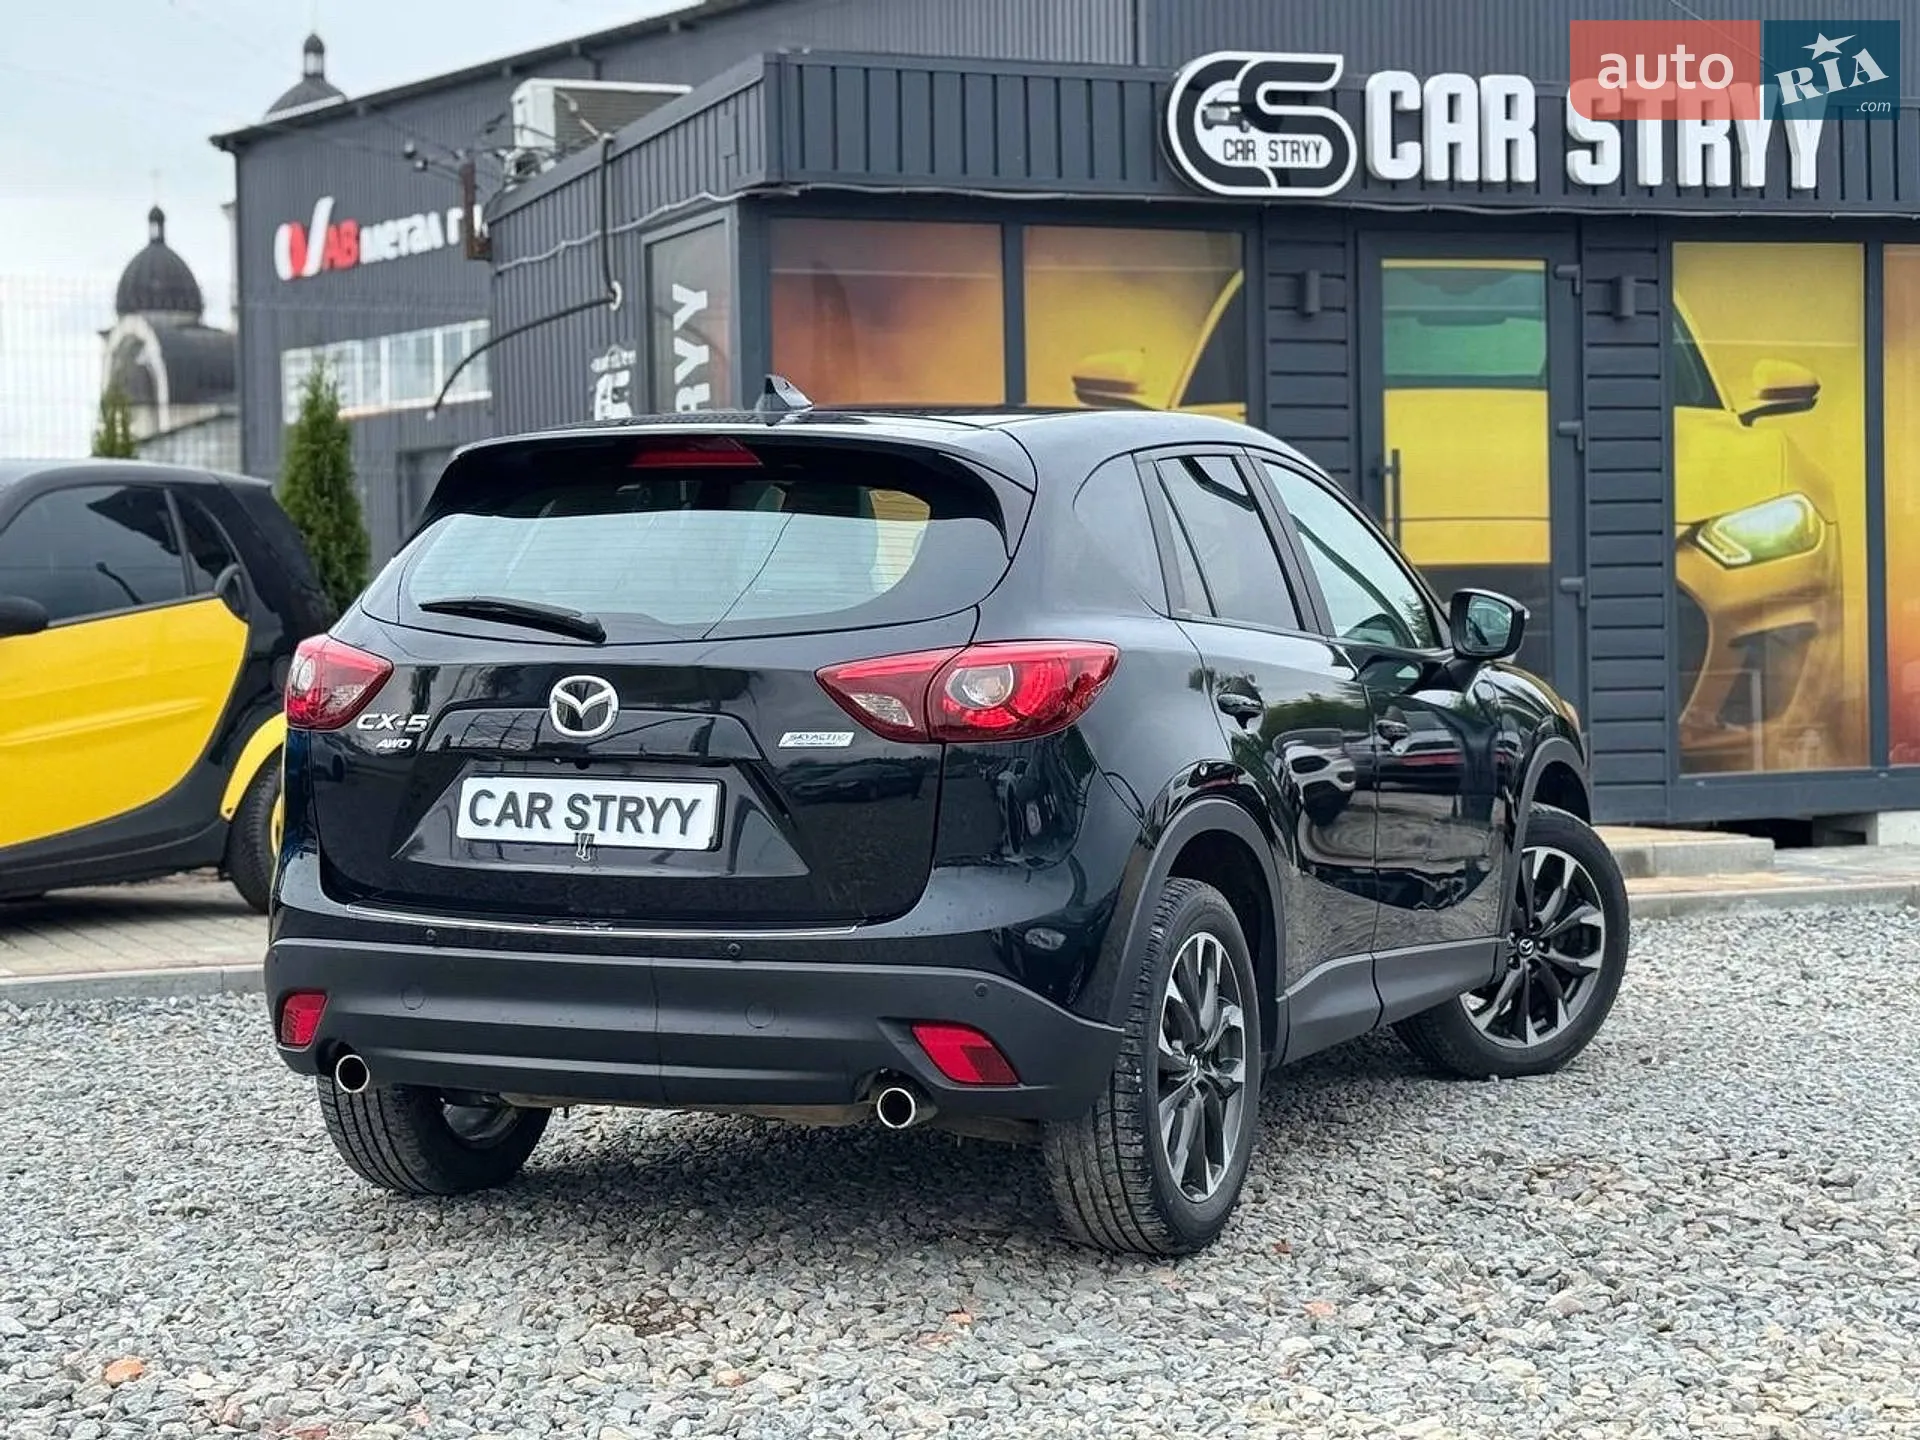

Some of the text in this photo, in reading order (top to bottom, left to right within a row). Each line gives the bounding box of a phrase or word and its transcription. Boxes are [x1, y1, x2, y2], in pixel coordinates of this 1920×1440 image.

[1365, 70, 1829, 190] CAR STRYY
[1223, 138, 1323, 164] CAR STRYY
[671, 282, 711, 413] RYY
[356, 712, 431, 733] CX-5
[375, 737, 413, 750] AWD
[468, 789, 702, 836] CAR STRYY
